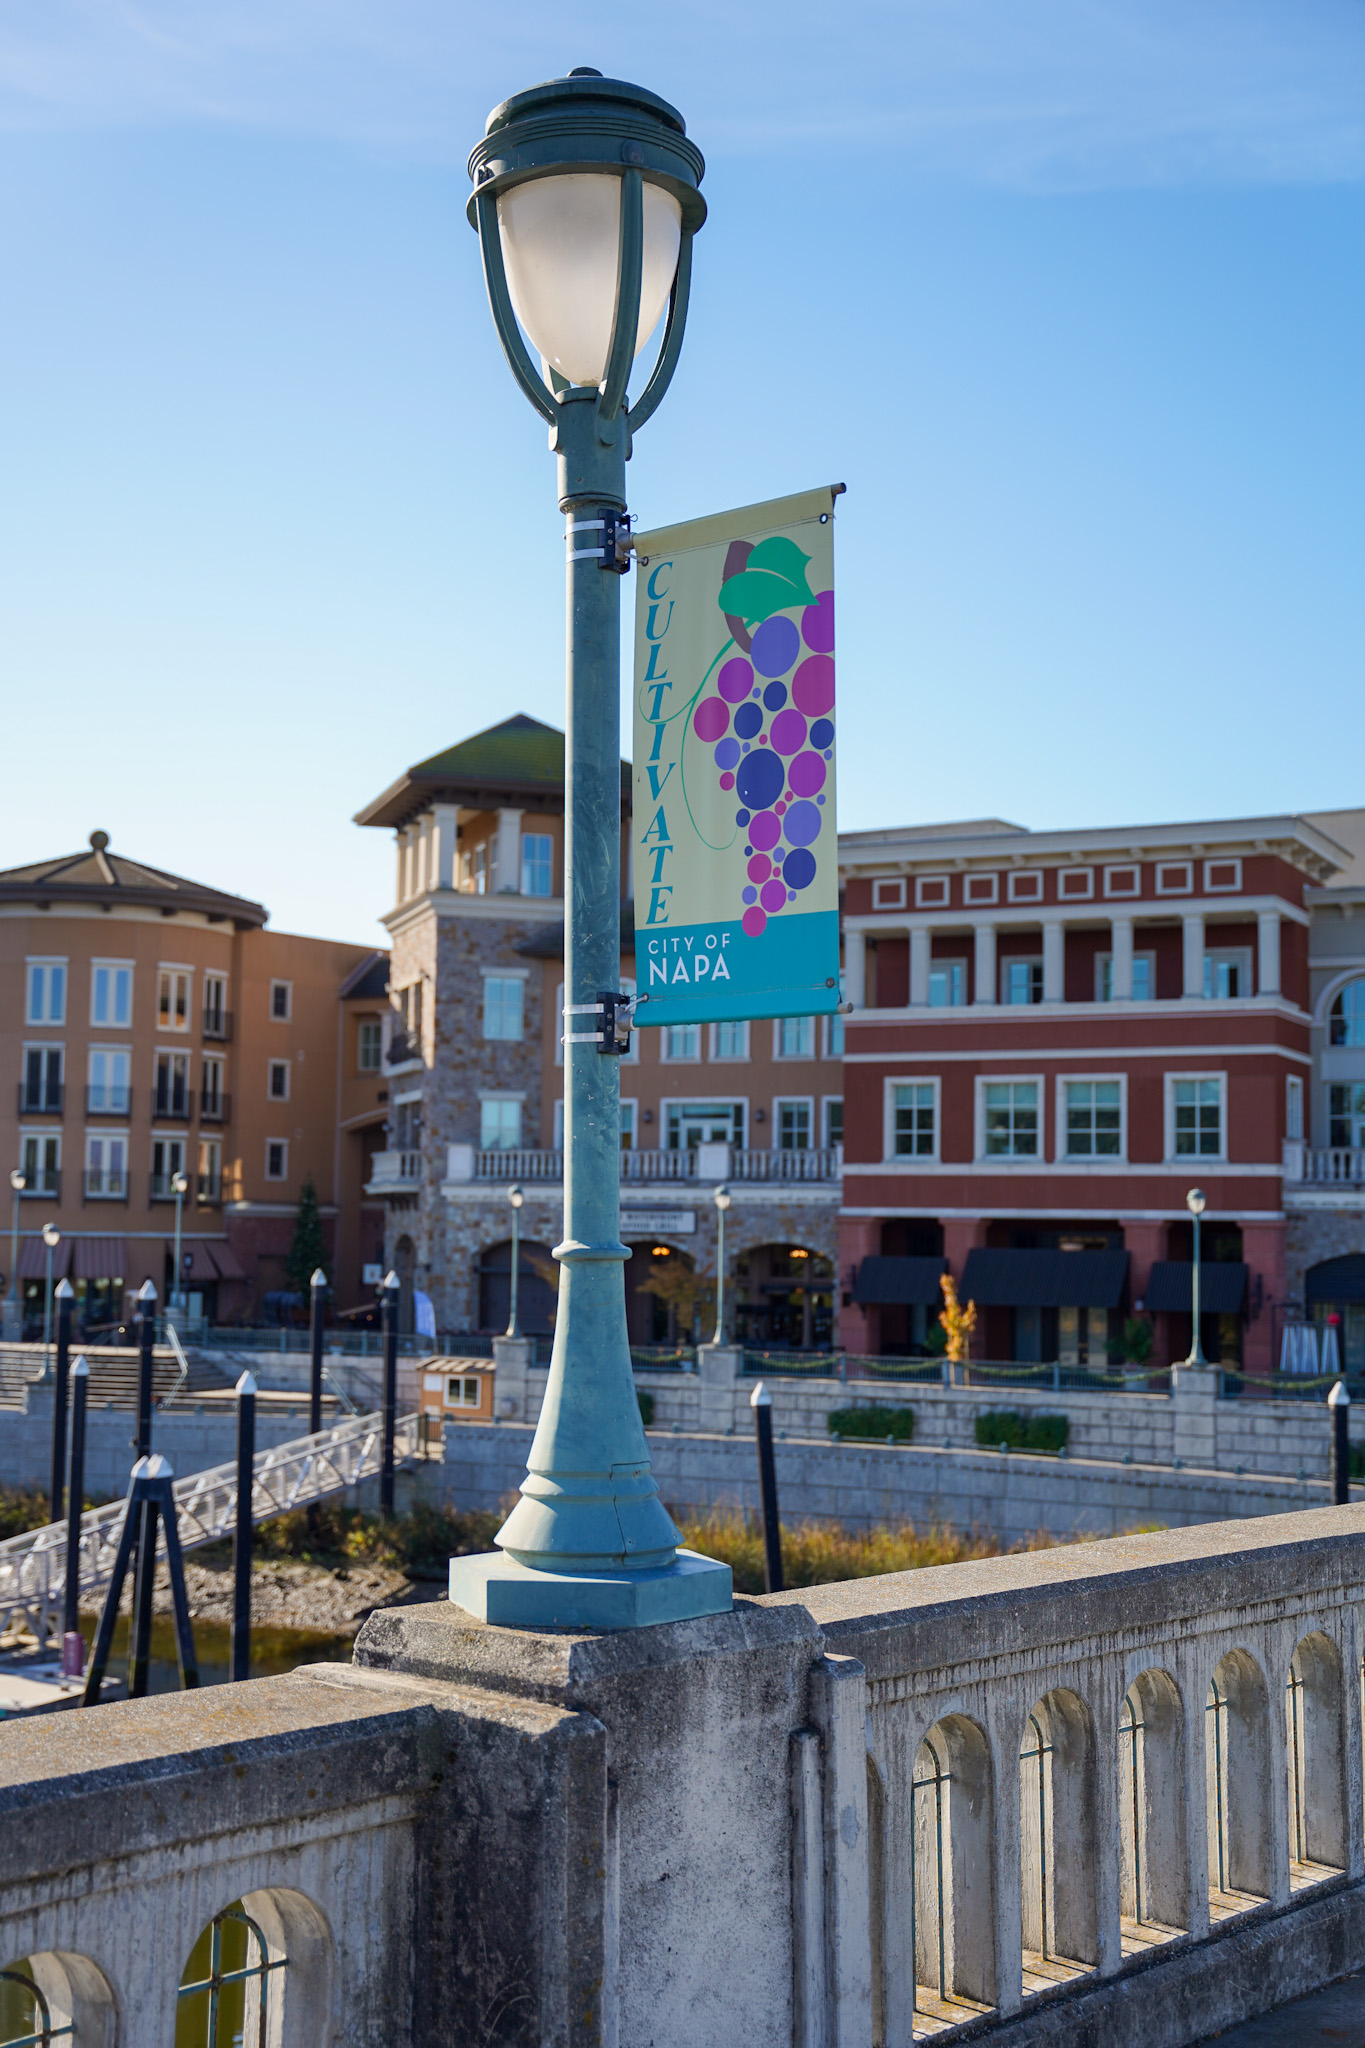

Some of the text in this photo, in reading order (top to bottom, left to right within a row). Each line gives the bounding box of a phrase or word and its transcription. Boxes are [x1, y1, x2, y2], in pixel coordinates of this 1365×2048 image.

[640, 561, 676, 925] CULTIVATE
[648, 933, 731, 955] CITY OF
[649, 952, 731, 986] NAPA
